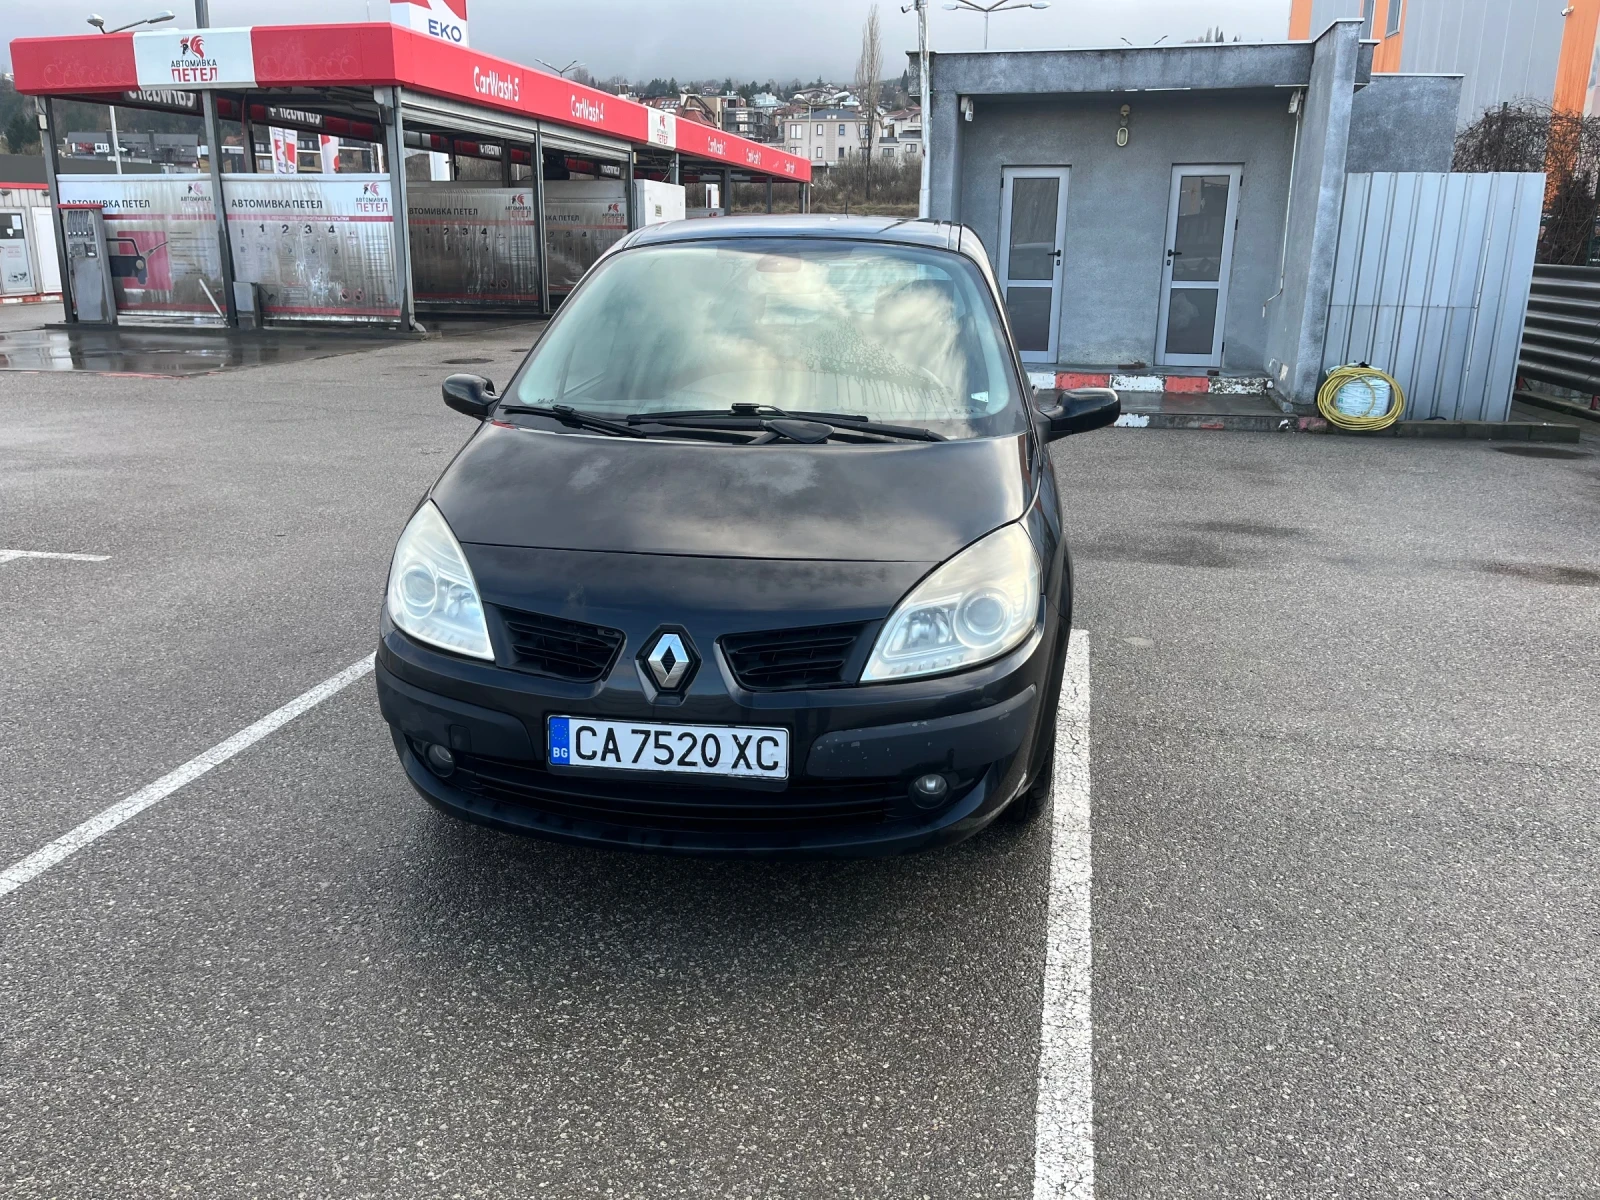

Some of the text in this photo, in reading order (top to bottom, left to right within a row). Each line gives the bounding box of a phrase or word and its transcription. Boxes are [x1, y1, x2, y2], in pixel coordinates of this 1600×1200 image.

[428, 18, 462, 42] EKO
[171, 59, 217, 67] АВТОМИВКА
[171, 67, 217, 82] ПЕТЕЛ
[474, 66, 519, 102] CarWash 5
[570, 95, 600, 122] CarWash
[122, 199, 150, 208] ПЕТЕЛ
[231, 199, 323, 209] АВТОМИВКА ПЕТЕЛ
[356, 202, 388, 213] ПЕТЕЛ
[408, 207, 478, 216] ВТОМИВКА ПЕТЕЛ
[259, 224, 265, 232] 1
[281, 224, 289, 233] 2
[305, 225, 312, 234] 3
[328, 225, 335, 233] 4
[553, 747, 568, 758] BG
[575, 726, 779, 771] CA 7520 XC
